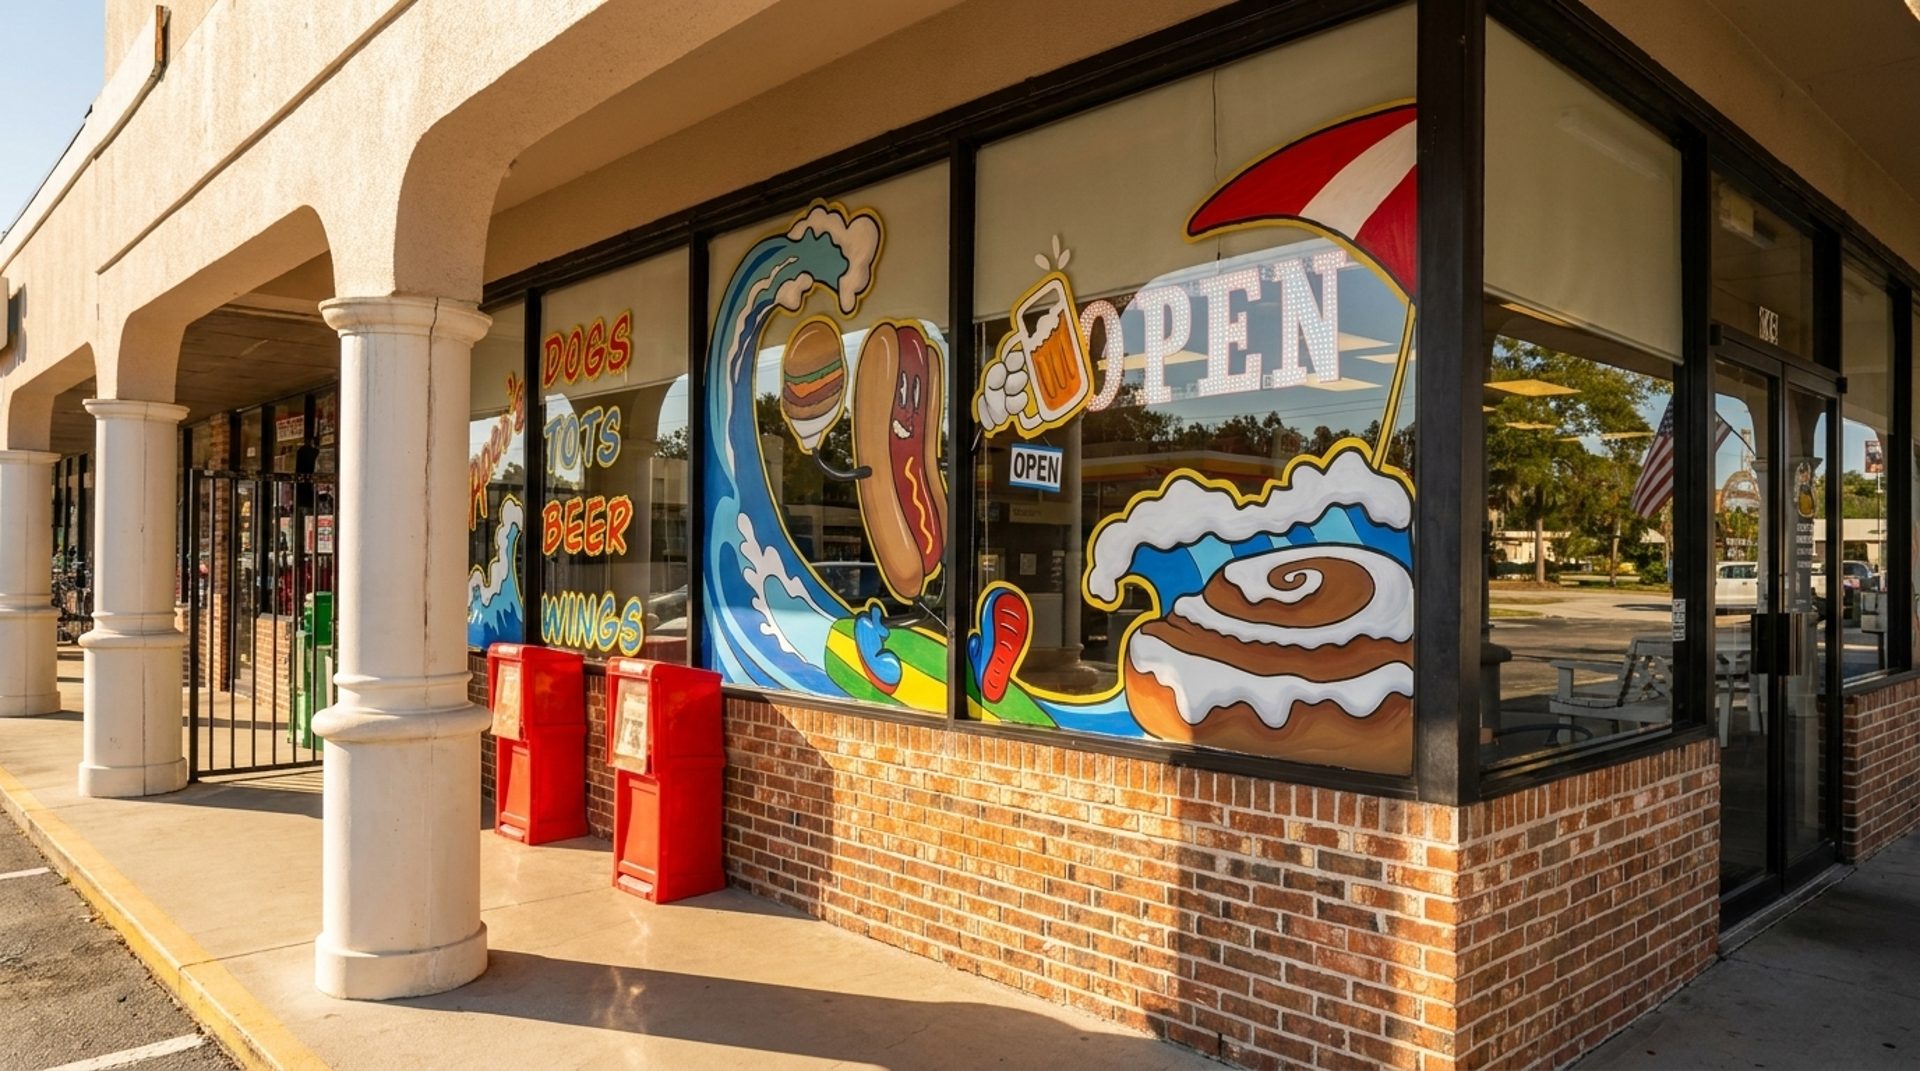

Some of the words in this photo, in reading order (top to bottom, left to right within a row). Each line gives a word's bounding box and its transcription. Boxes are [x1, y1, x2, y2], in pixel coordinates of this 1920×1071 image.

[543, 308, 632, 389] DOGS
[1079, 248, 1348, 412] OPEN
[543, 405, 622, 474] TOTS
[1013, 452, 1060, 483] OPEN
[542, 494, 633, 557] BEER
[541, 590, 645, 657] WINGS
